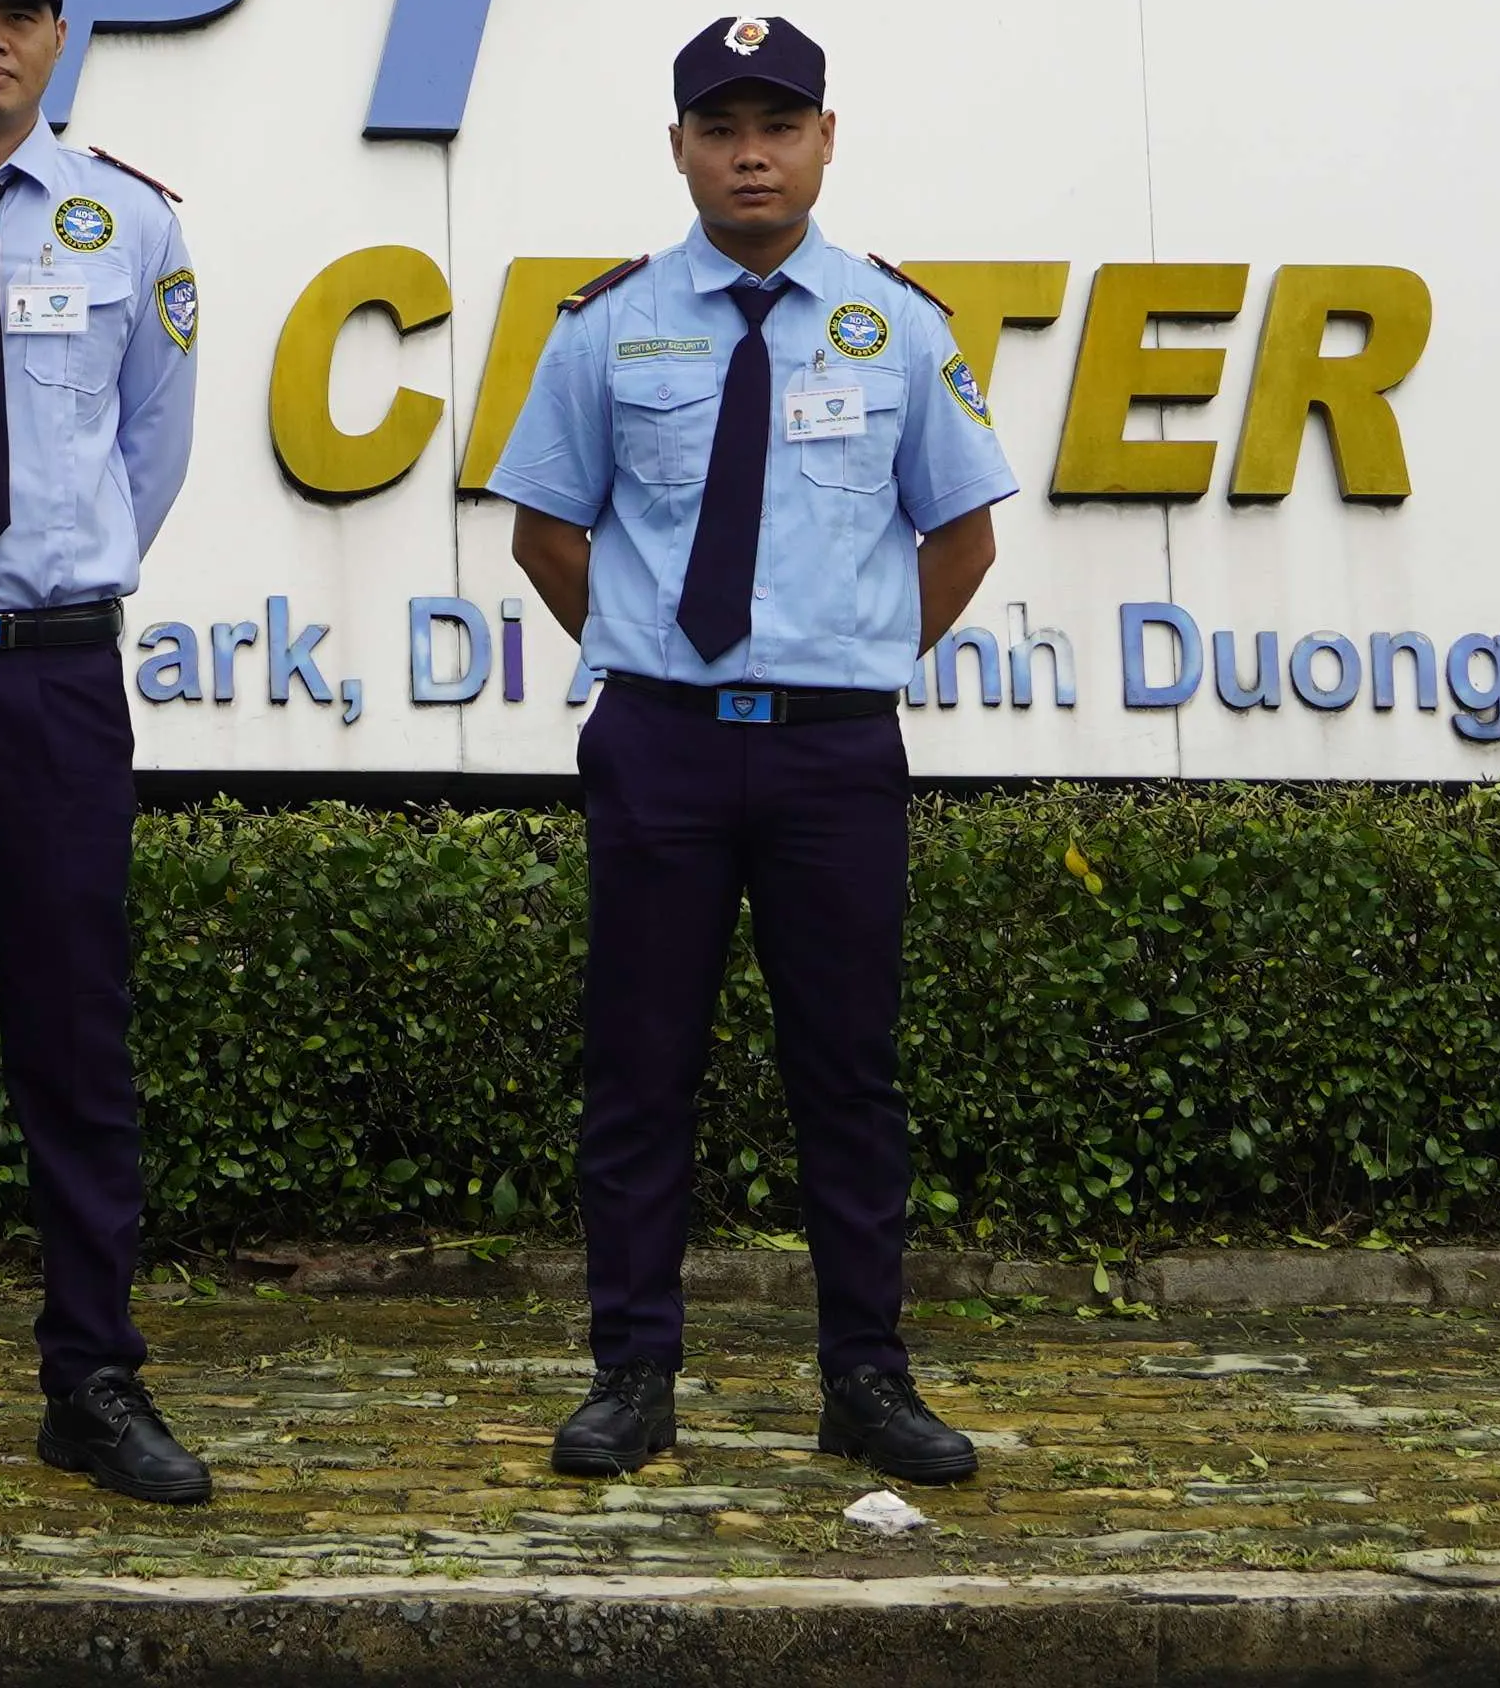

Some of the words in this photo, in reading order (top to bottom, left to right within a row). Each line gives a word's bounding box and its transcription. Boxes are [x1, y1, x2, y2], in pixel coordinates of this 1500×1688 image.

[668, 341, 707, 351] SECURITY
[136, 595, 363, 724] ark,
[408, 596, 525, 705] Di
